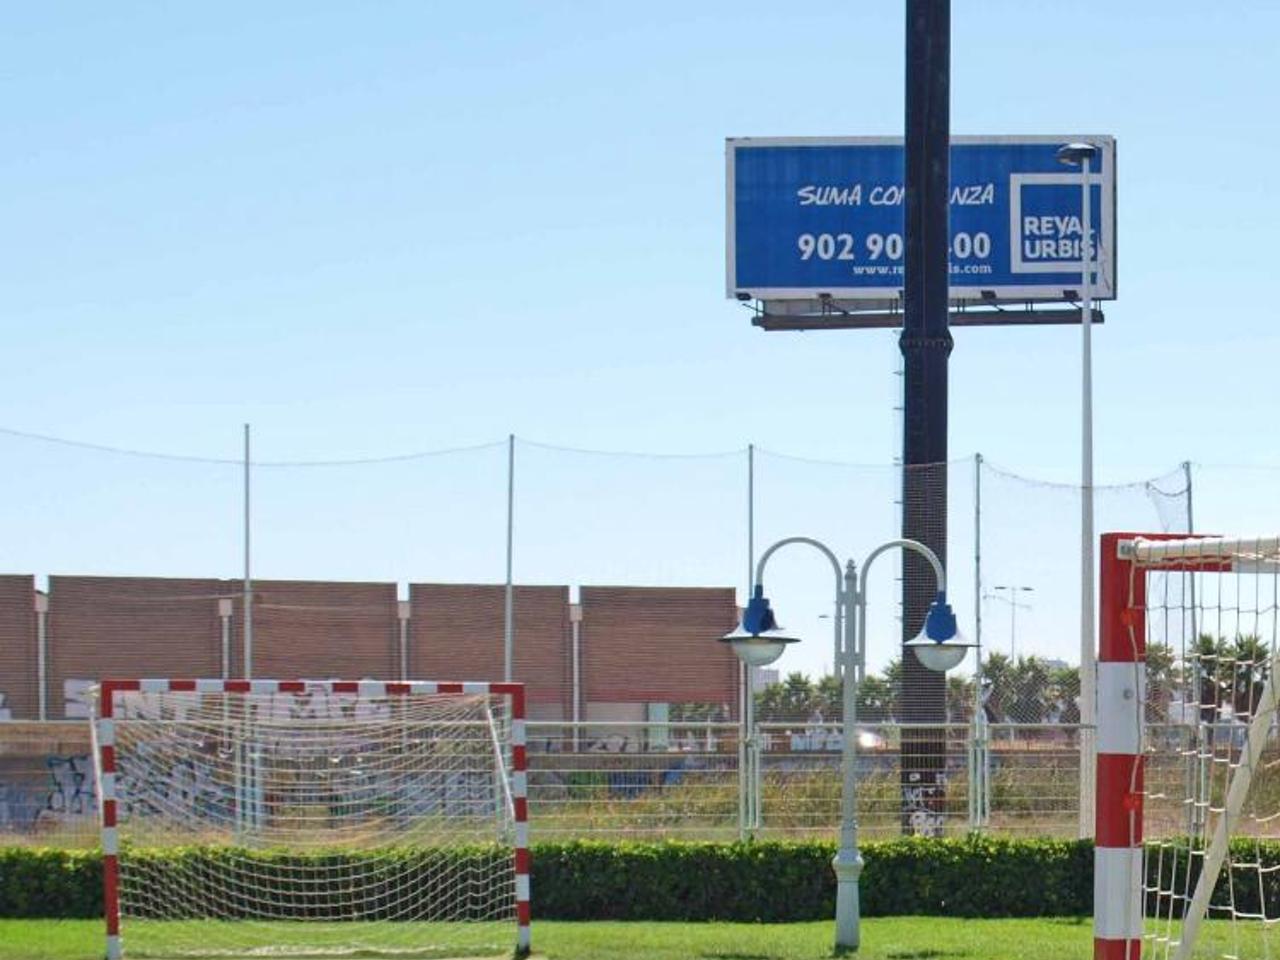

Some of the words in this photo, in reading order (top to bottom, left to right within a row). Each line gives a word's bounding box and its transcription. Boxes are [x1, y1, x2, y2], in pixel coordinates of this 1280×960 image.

[797, 184, 861, 206] SUMA
[869, 184, 994, 206] CONZA
[798, 233, 854, 260] 902
[866, 233, 906, 260] 90
[946, 232, 991, 259] 00
